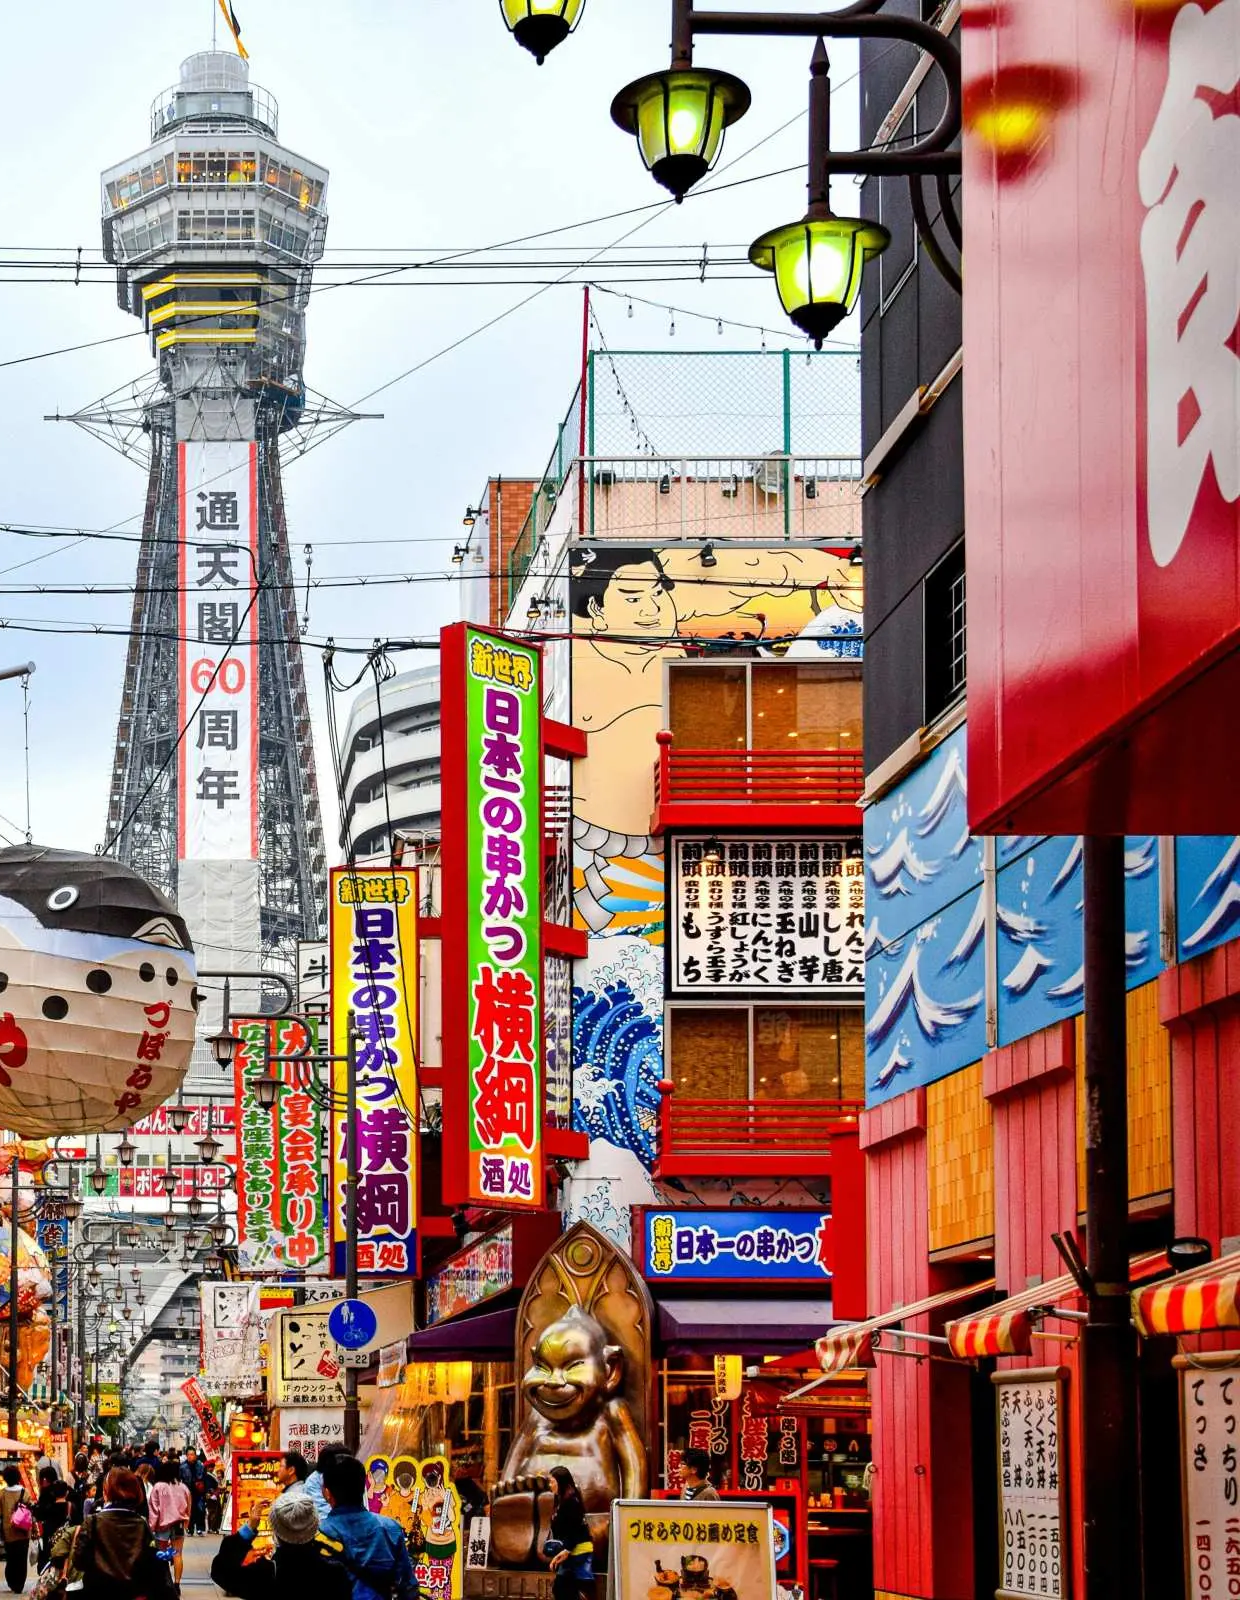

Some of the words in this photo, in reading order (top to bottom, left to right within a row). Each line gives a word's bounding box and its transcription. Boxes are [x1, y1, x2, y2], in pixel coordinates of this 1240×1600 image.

[190, 491, 246, 810] 通天閣60周年
[471, 642, 533, 691] 新世界
[483, 689, 526, 963] 日本一の串かつ
[339, 876, 410, 905] 新世界
[682, 912, 702, 983] もち
[706, 912, 726, 983] うずら玉子
[729, 912, 750, 983] 紅しょうが
[752, 912, 772, 983] にんにく
[775, 912, 796, 983] 玉ねぎ
[799, 912, 819, 983] 山芋
[822, 912, 843, 983] しし唐
[846, 912, 864, 983] れんこん
[352, 907, 398, 1102] 日本一の串かつ
[114, 1000, 173, 1115] づぼらや
[473, 966, 536, 1150] 横綱
[135, 1109, 234, 1132] みんで楽し
[340, 1107, 409, 1241] 横綱
[482, 1156, 531, 1196] 酒処
[676, 1229, 815, 1262] 日本一の串かつ
[1192, 1379, 1208, 1472] てっさ
[1220, 1377, 1238, 1506] てっちり
